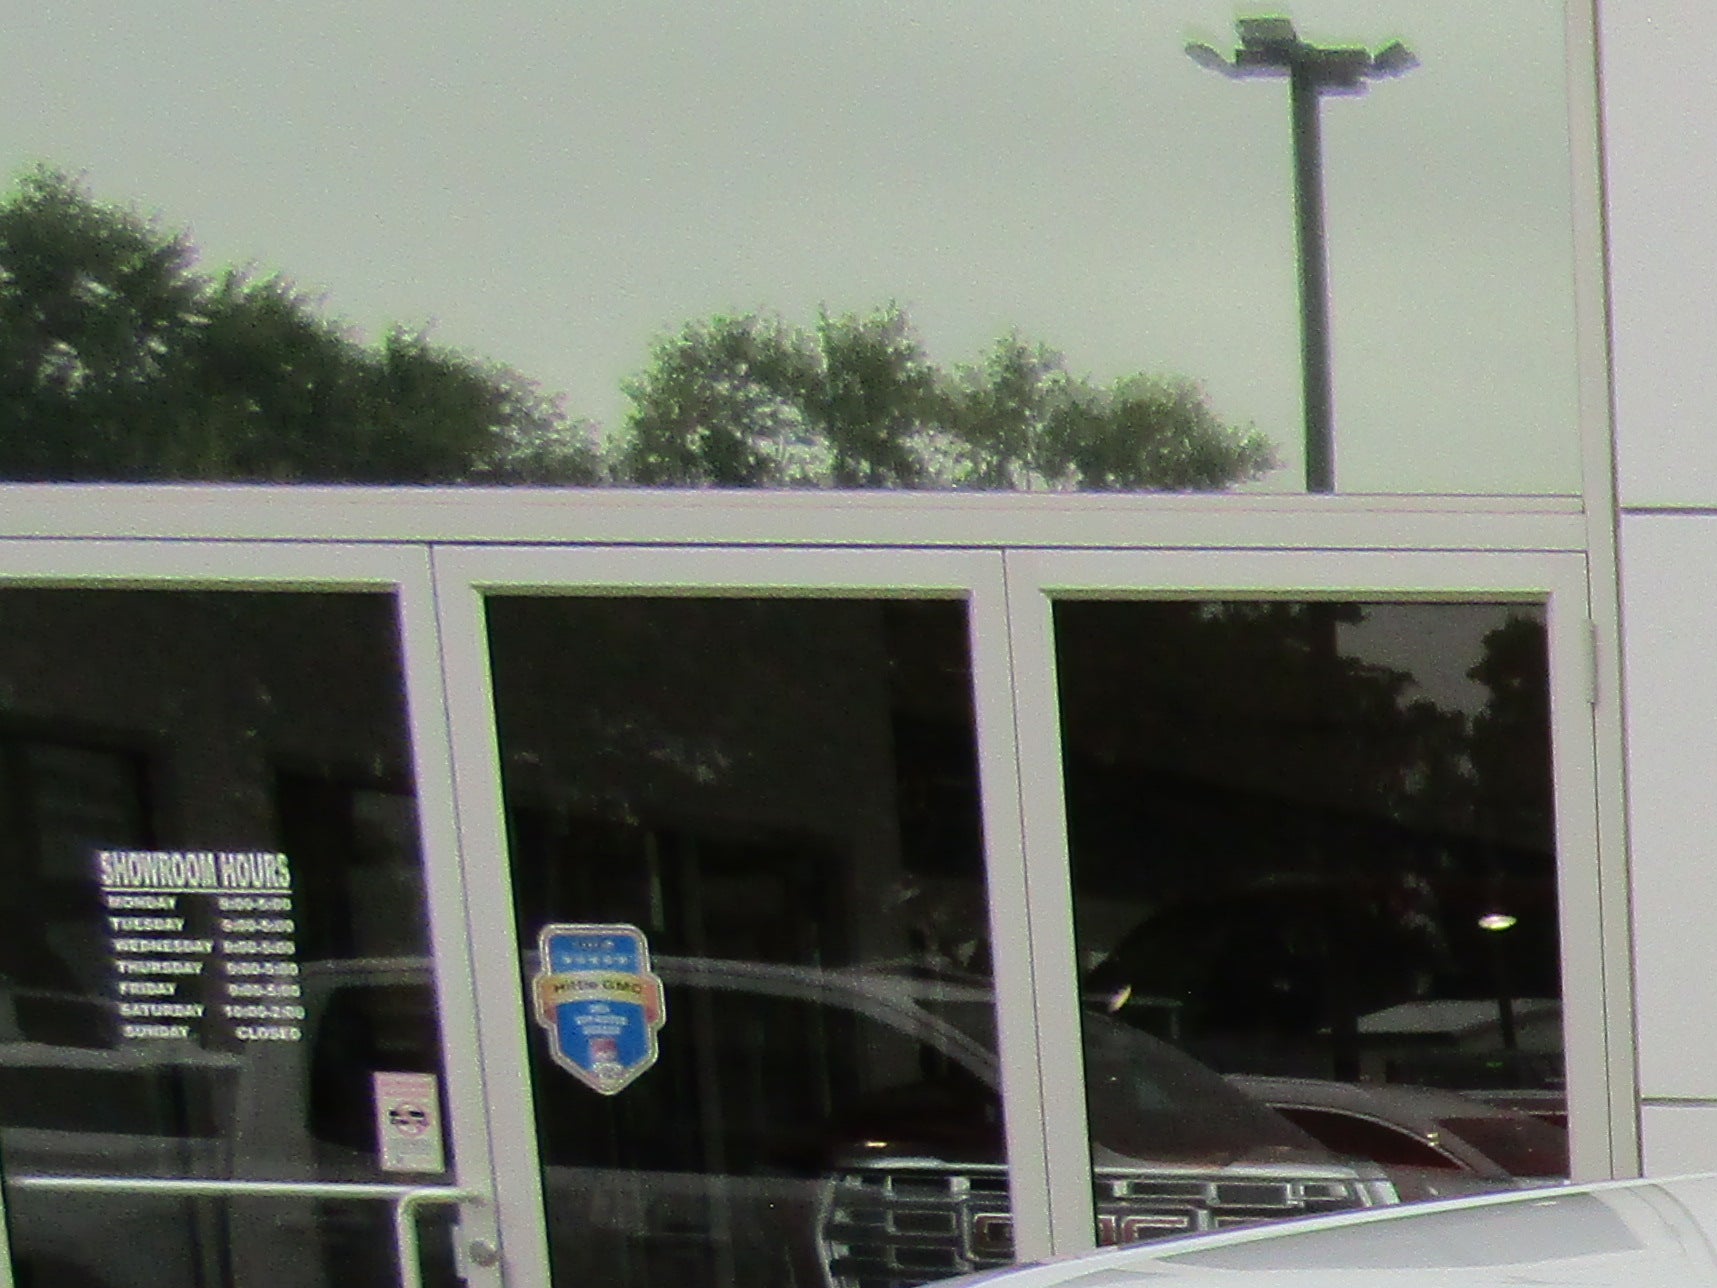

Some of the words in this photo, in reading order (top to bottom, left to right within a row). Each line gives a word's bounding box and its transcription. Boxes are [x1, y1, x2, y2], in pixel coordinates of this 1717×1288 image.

[100, 851, 218, 887] SHOWROOM
[220, 852, 291, 888] HOURS
[108, 896, 177, 910] MONDAY
[109, 917, 184, 931] TUESDAY
[113, 939, 214, 953] WEDNESDAY
[116, 961, 203, 975] THURSDAY
[118, 982, 177, 996] FRIDAY
[119, 1003, 205, 1018] SATURDAY
[122, 1025, 190, 1039] SUNDAY
[235, 1027, 302, 1041] CLOSED
